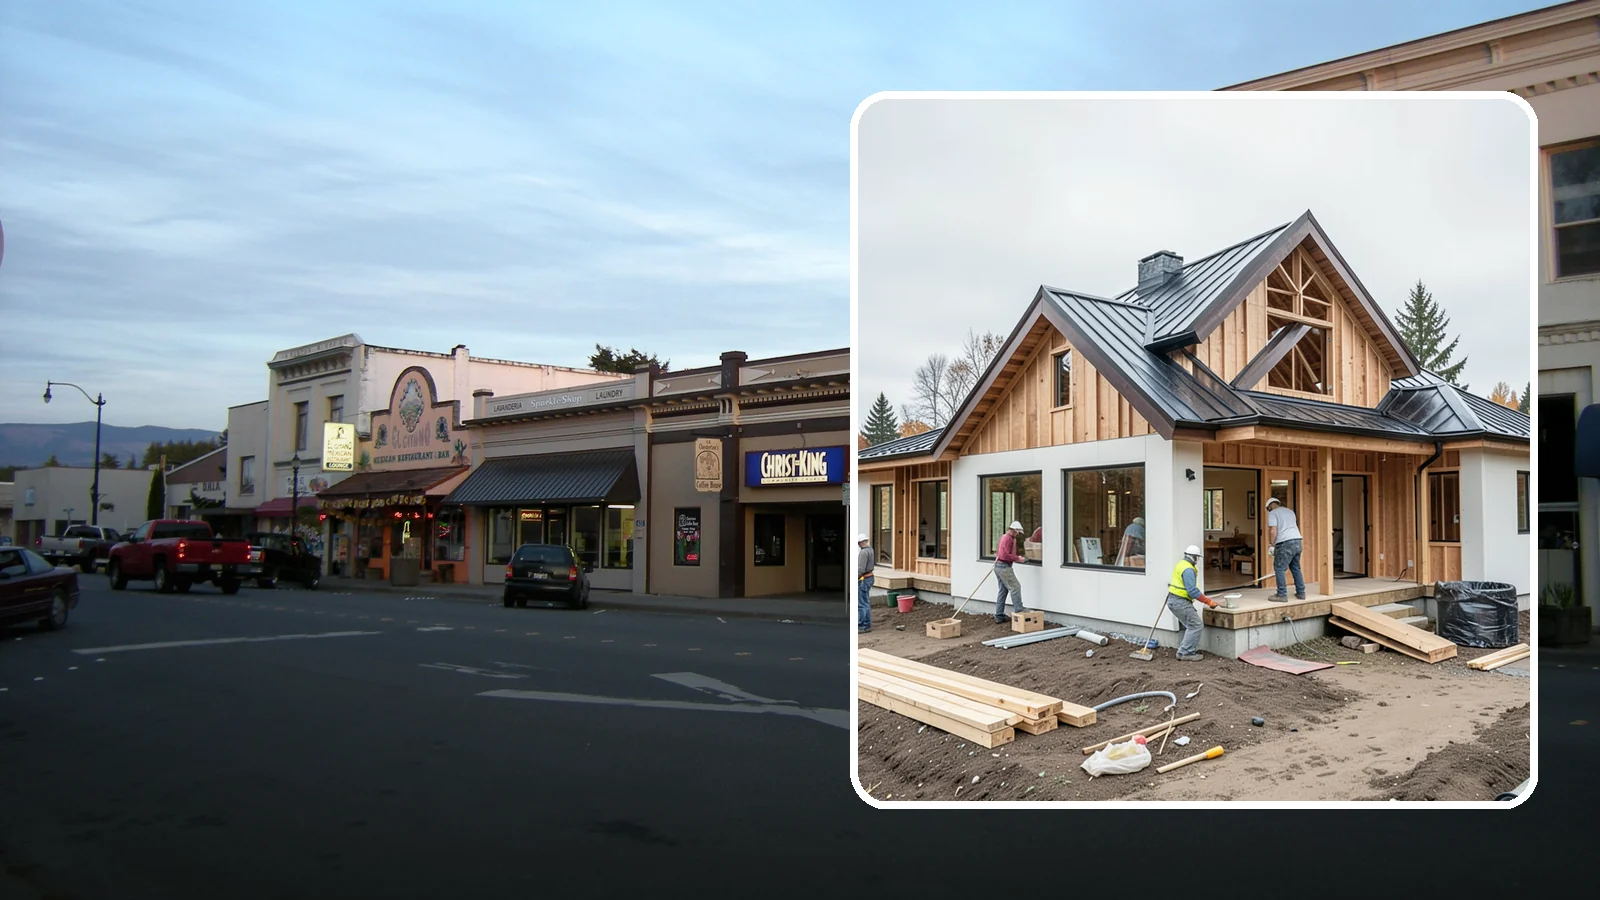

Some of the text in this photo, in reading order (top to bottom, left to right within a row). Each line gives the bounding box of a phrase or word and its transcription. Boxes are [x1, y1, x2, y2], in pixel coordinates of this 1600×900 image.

[493, 388, 624, 413] LAVANDERIA Sparkle Shop LAUNDRY
[373, 454, 396, 464] MEXICAN
[397, 451, 433, 462] RESTAURANT
[438, 450, 450, 459] BAR
[761, 452, 797, 478] CHRIST
[799, 450, 827, 477] KING
